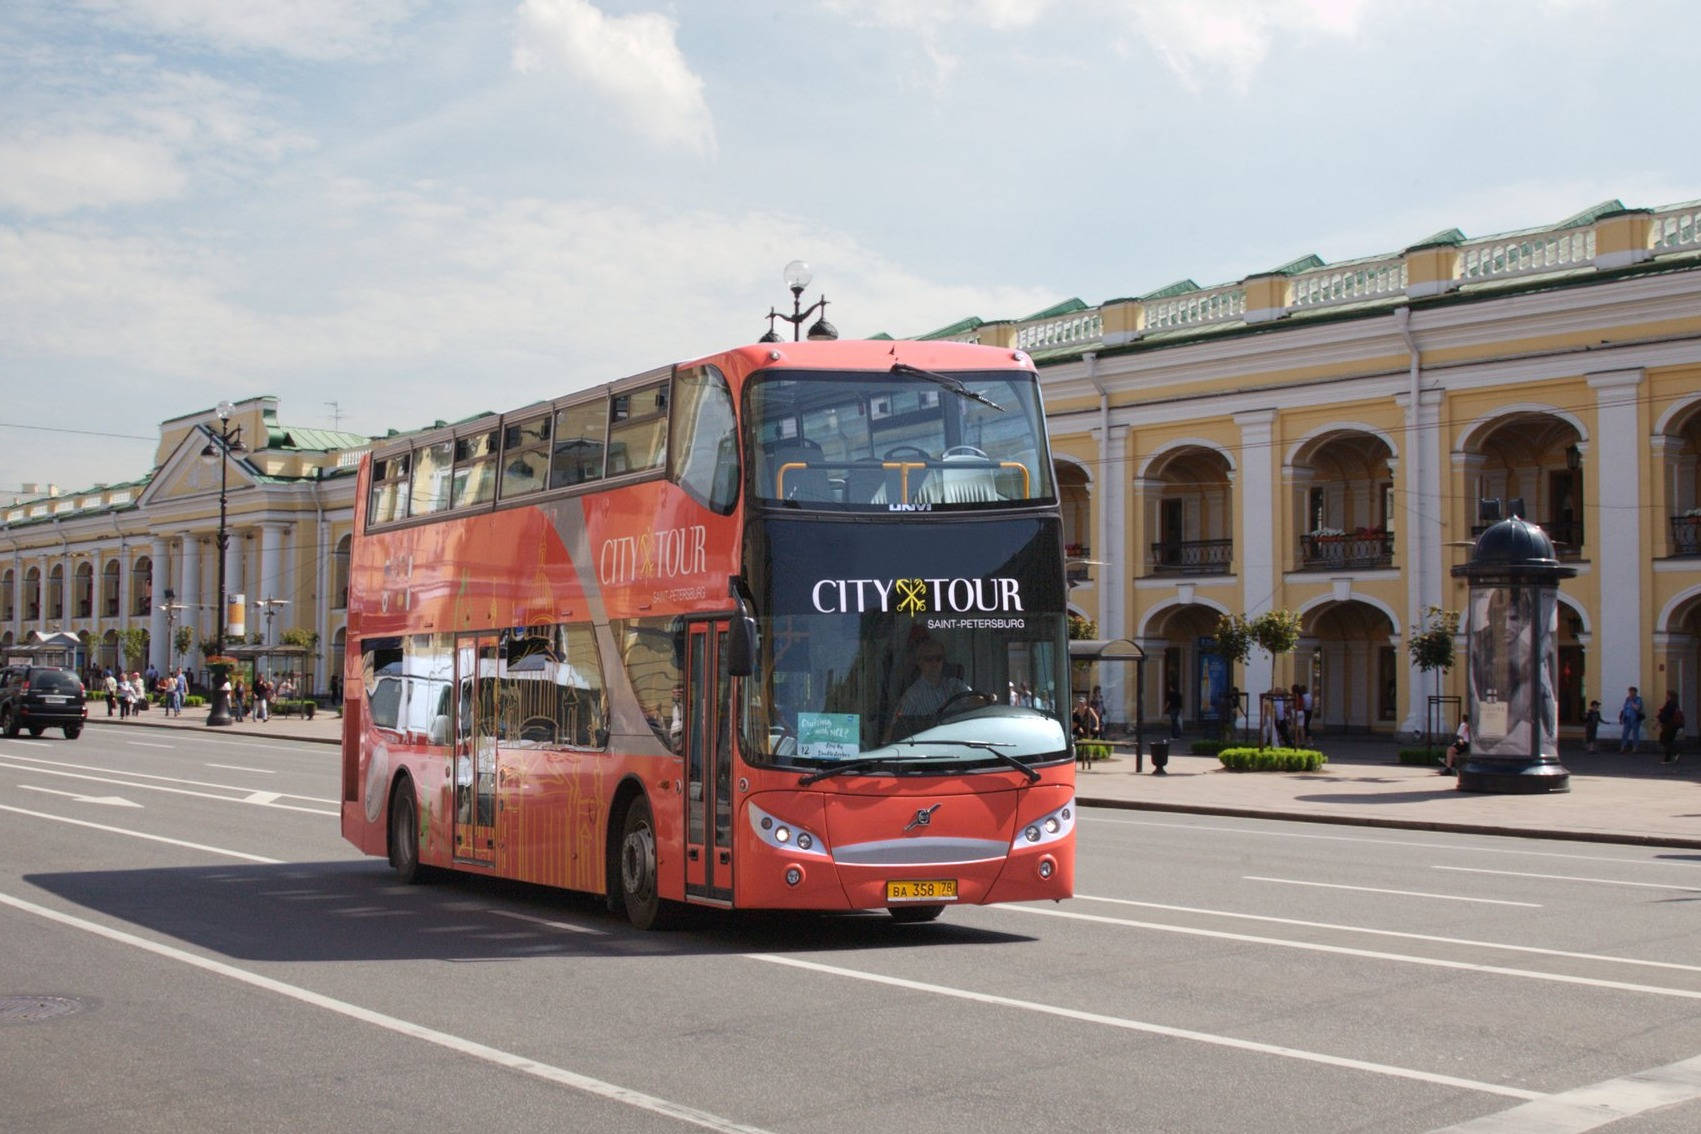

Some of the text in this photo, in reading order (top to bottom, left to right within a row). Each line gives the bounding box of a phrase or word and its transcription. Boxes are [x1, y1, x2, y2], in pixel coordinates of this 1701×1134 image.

[600, 525, 706, 585] CITY TOUR
[811, 577, 1025, 613] CITY TOUR
[926, 618, 1026, 630] SAINT-PETERSBURG
[892, 881, 953, 897] BA 358 78
